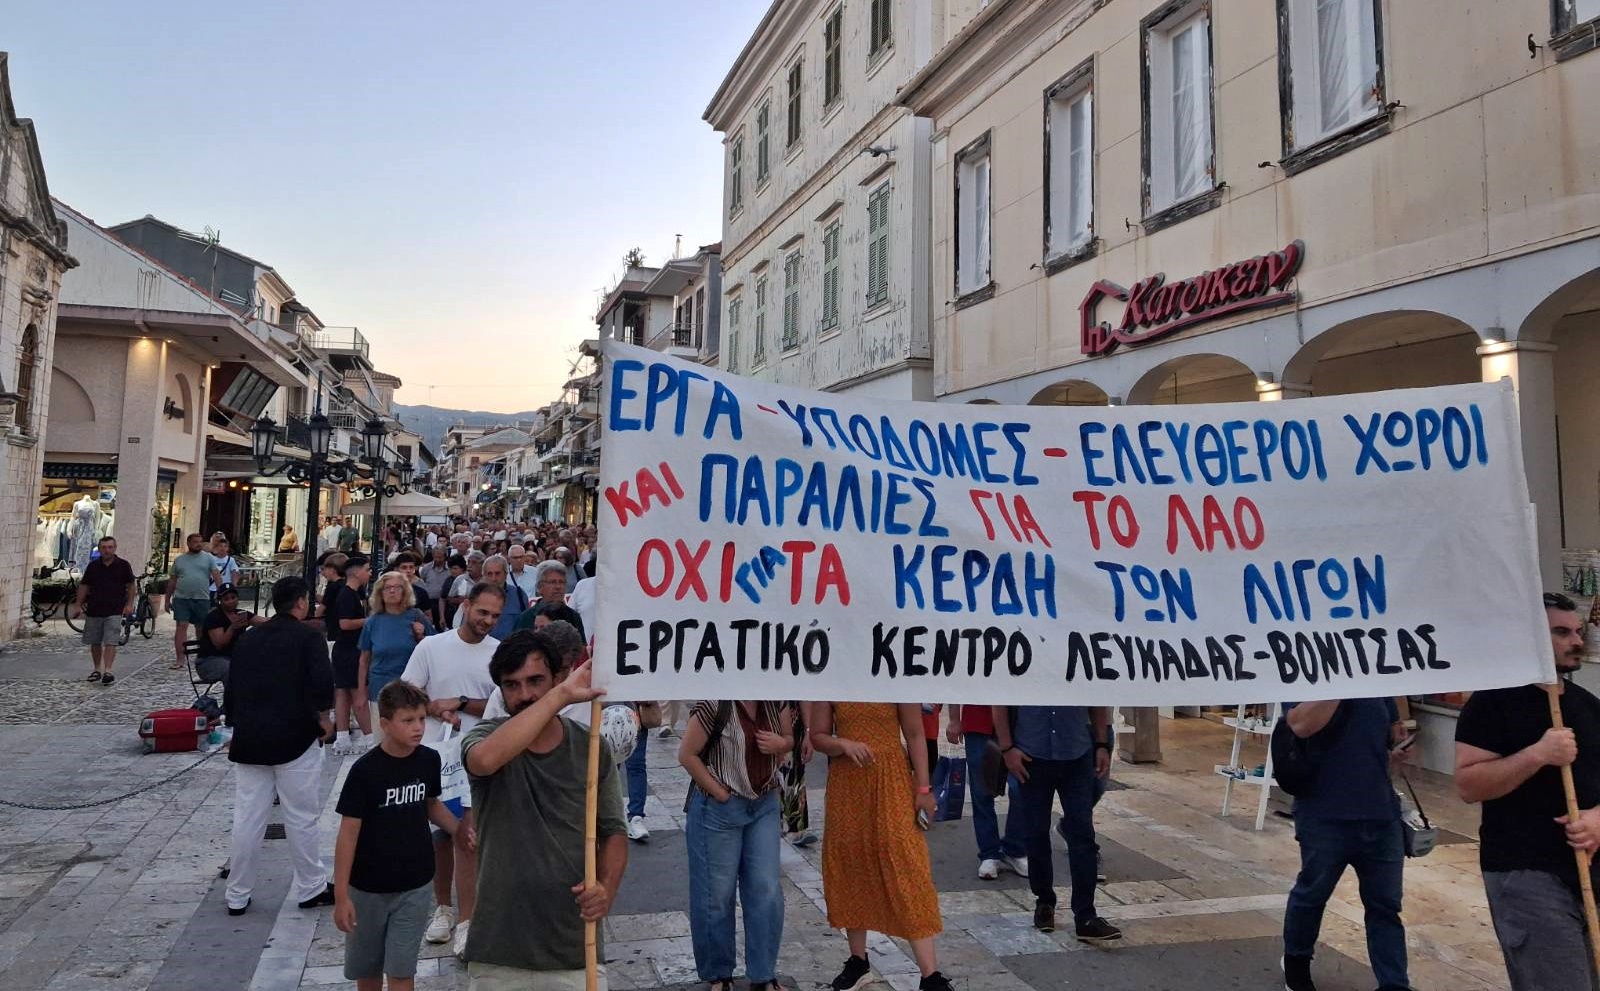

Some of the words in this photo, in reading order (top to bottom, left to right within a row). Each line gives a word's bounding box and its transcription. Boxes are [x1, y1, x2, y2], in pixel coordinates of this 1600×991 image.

[609, 360, 743, 441] ΕΡΓΑ
[1079, 419, 1328, 487] ΕΛΕΥΘΕΡΟΙ
[1343, 403, 1489, 476] ΧΩΡΟΙ
[604, 462, 685, 528] ΚΑΙ
[699, 453, 950, 538] ΠΑΡΑΛΙΕΣ
[969, 489, 1052, 548] ΓΙΑ
[1072, 490, 1140, 550] ΤΟ
[1166, 494, 1265, 555] ΛΑΟ
[636, 538, 736, 603] ΟΧΙ
[734, 545, 787, 605] ΓΙΑ
[782, 540, 851, 606] ΤΑ
[892, 543, 1057, 620] ΚΕΡΔΗ
[1094, 560, 1198, 624] ΤΩΝ
[1243, 554, 1387, 625] ΛΙΓΩΝ
[871, 621, 1033, 679] ΚΕΝΤΡΟ
[384, 782, 426, 807] PUMA
